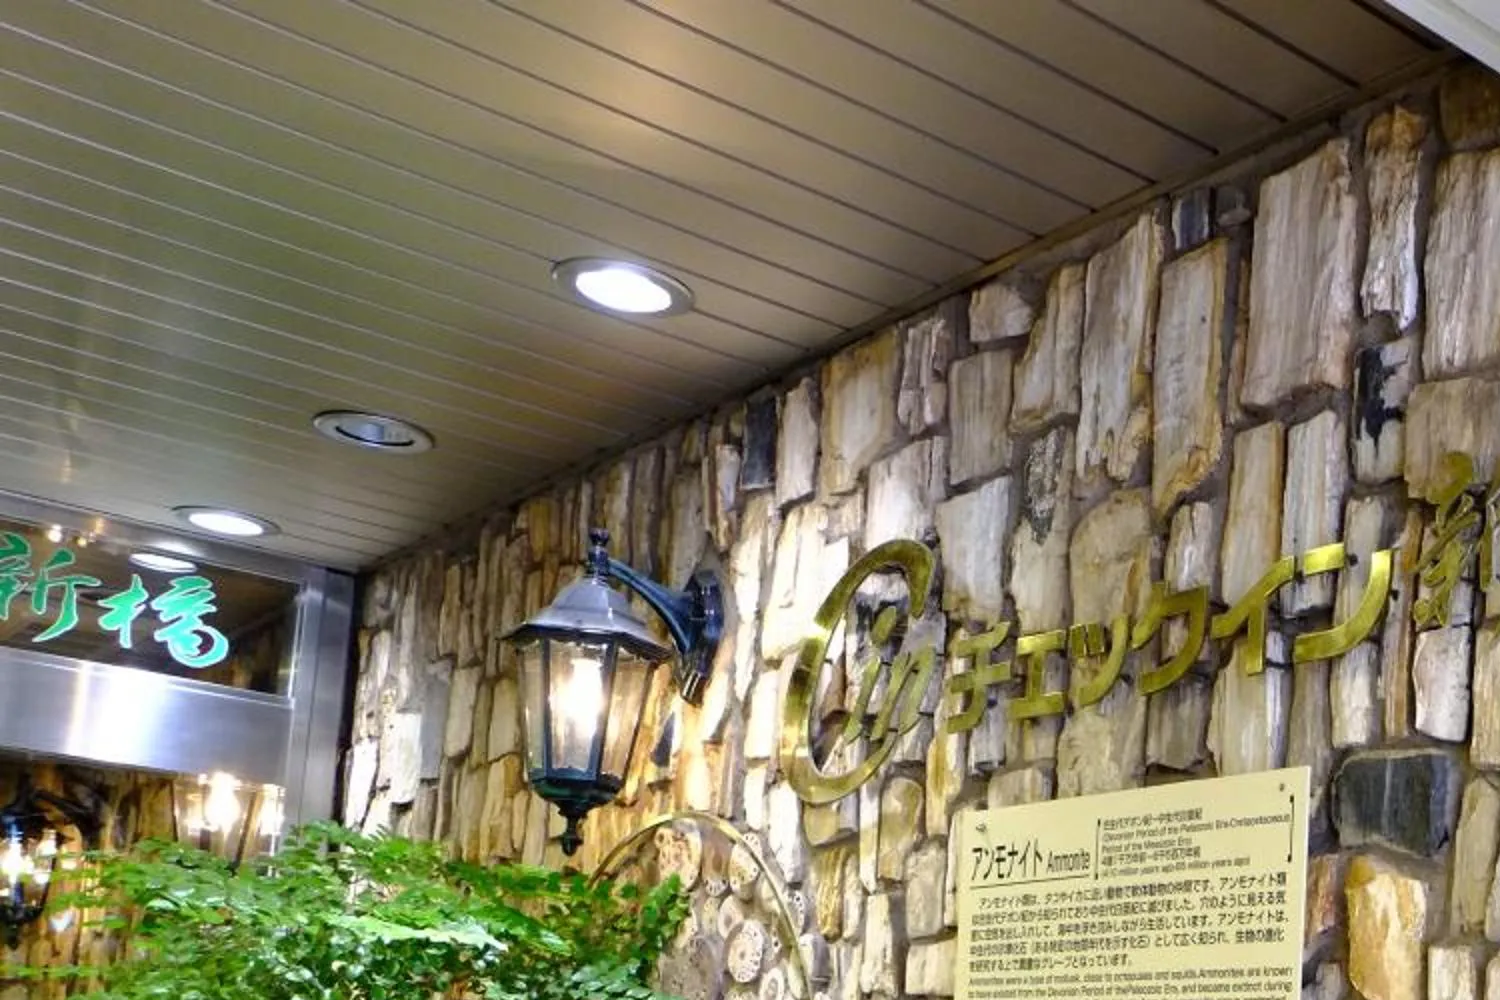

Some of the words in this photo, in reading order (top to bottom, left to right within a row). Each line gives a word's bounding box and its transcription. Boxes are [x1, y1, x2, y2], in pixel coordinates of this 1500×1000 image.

[970, 846, 1044, 882] アンモナイト
[1046, 848, 1091, 872] Ammonite
